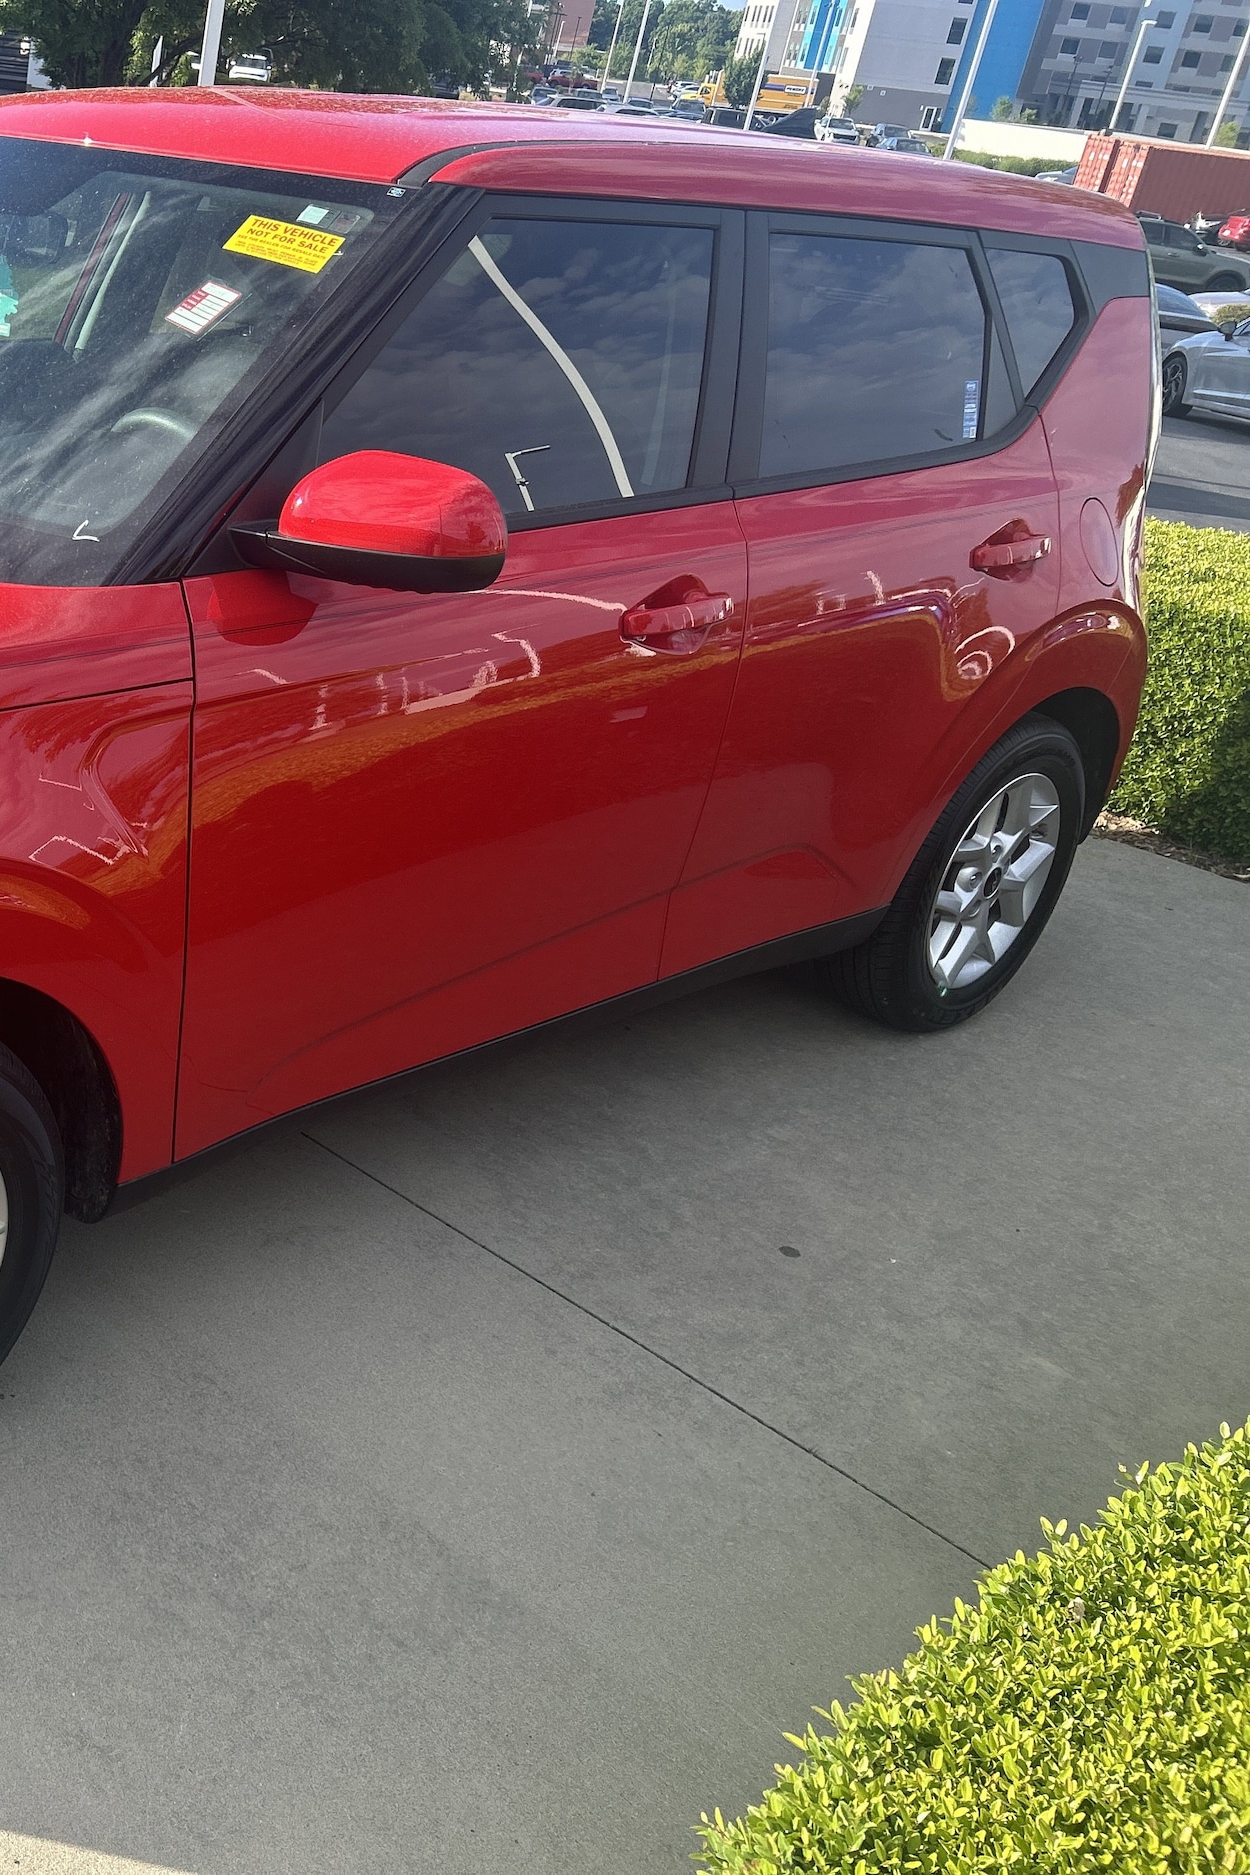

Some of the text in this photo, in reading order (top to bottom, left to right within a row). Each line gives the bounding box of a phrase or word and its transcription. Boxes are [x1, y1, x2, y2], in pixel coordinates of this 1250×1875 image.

[247, 228, 271, 238] NOT
[272, 234, 296, 245] FOR
[297, 240, 329, 254] SALE
[251, 218, 339, 247] THIS VEHICLE
